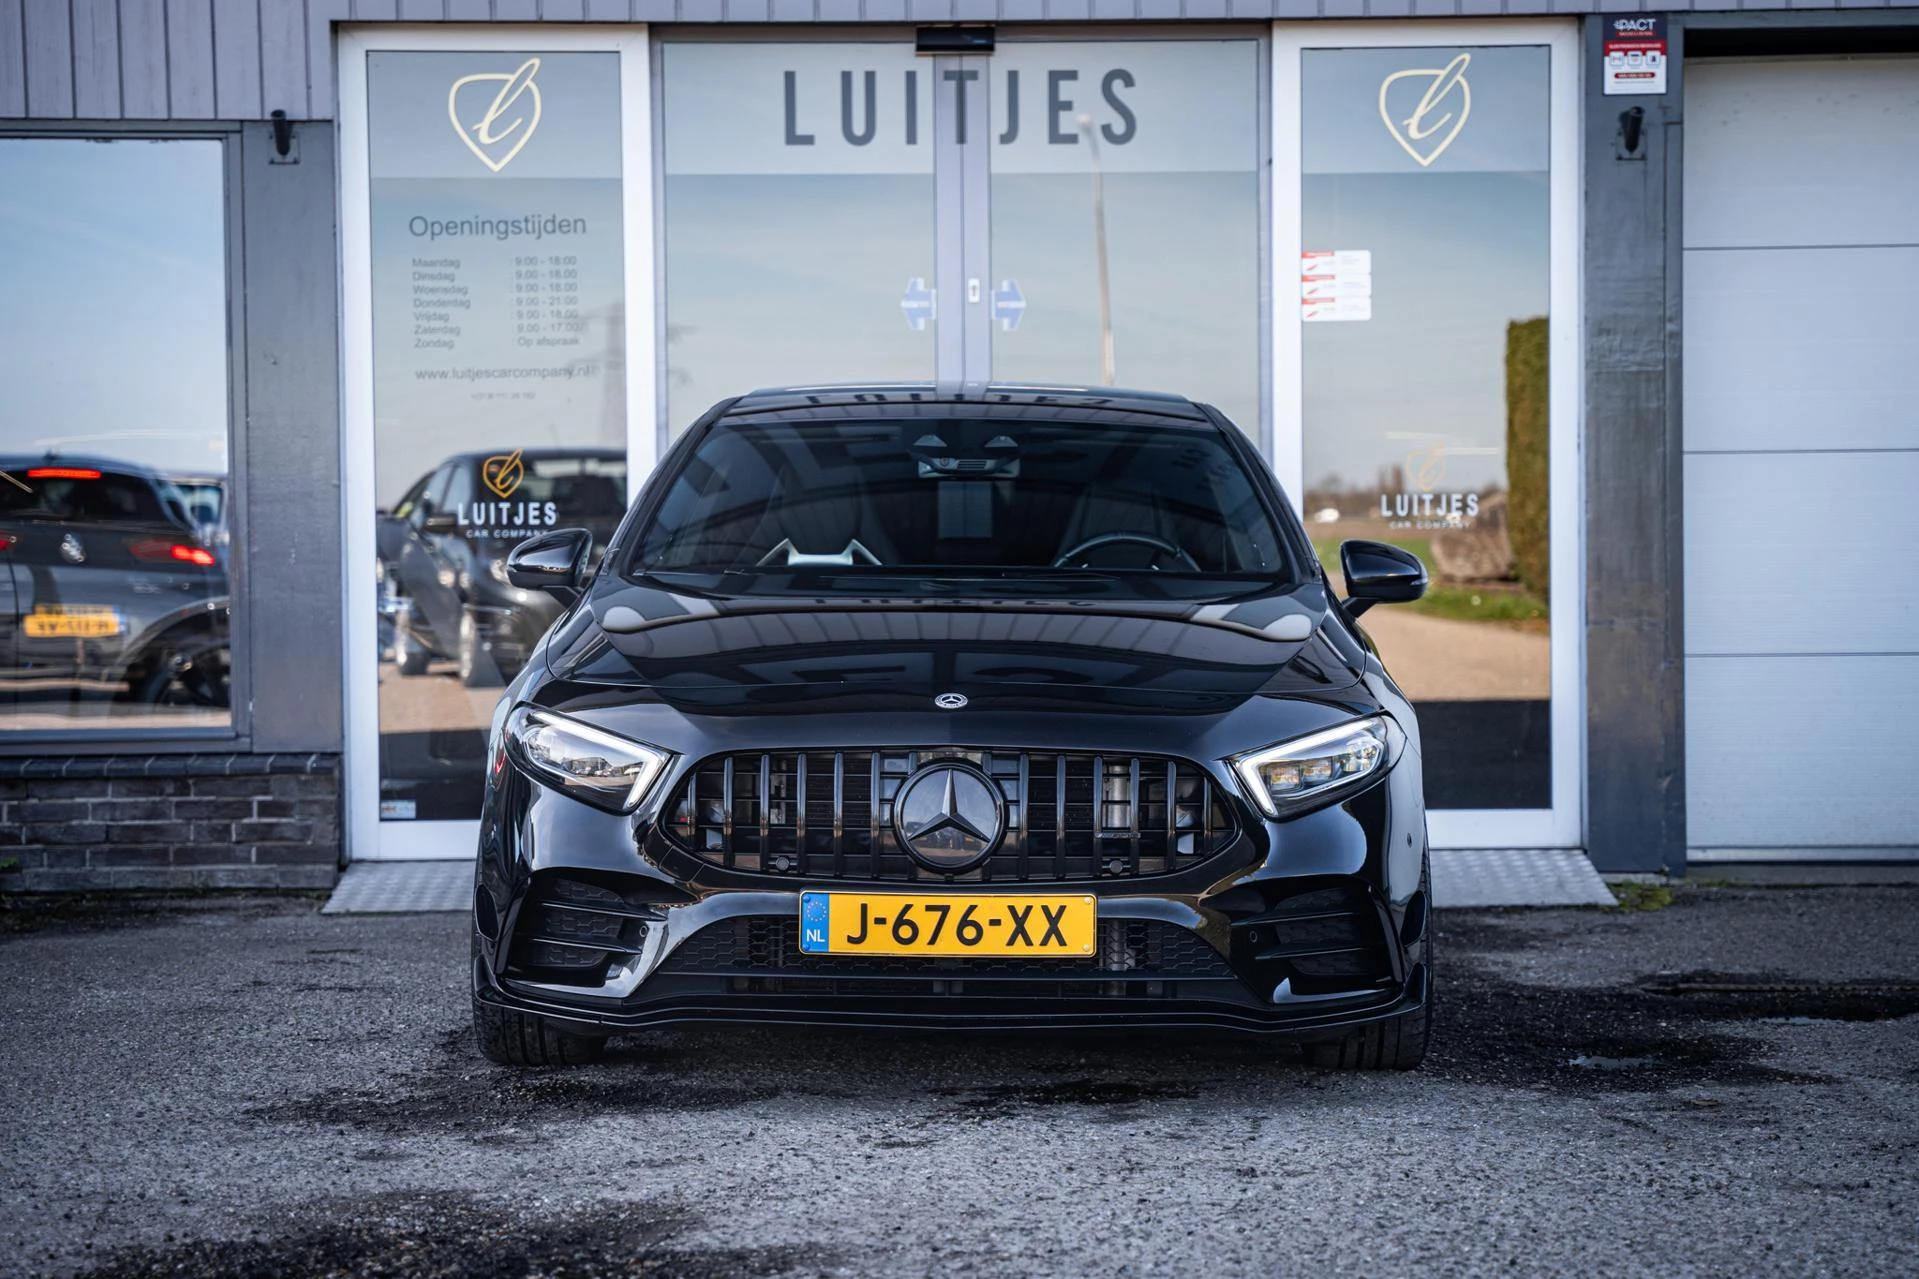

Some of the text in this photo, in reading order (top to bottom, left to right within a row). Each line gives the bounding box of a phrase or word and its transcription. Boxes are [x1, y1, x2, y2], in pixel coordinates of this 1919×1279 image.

[784, 68, 1137, 146] LUITJES
[408, 214, 588, 241] Openingstijden
[412, 258, 461, 269] Maandag
[412, 285, 469, 296] Woensdag
[413, 299, 471, 310] Donderdag
[414, 339, 455, 350] Zondag
[457, 502, 557, 526] LUITJES
[1380, 493, 1480, 517] LUITJES
[805, 903, 1068, 946] NL J-676-XX
